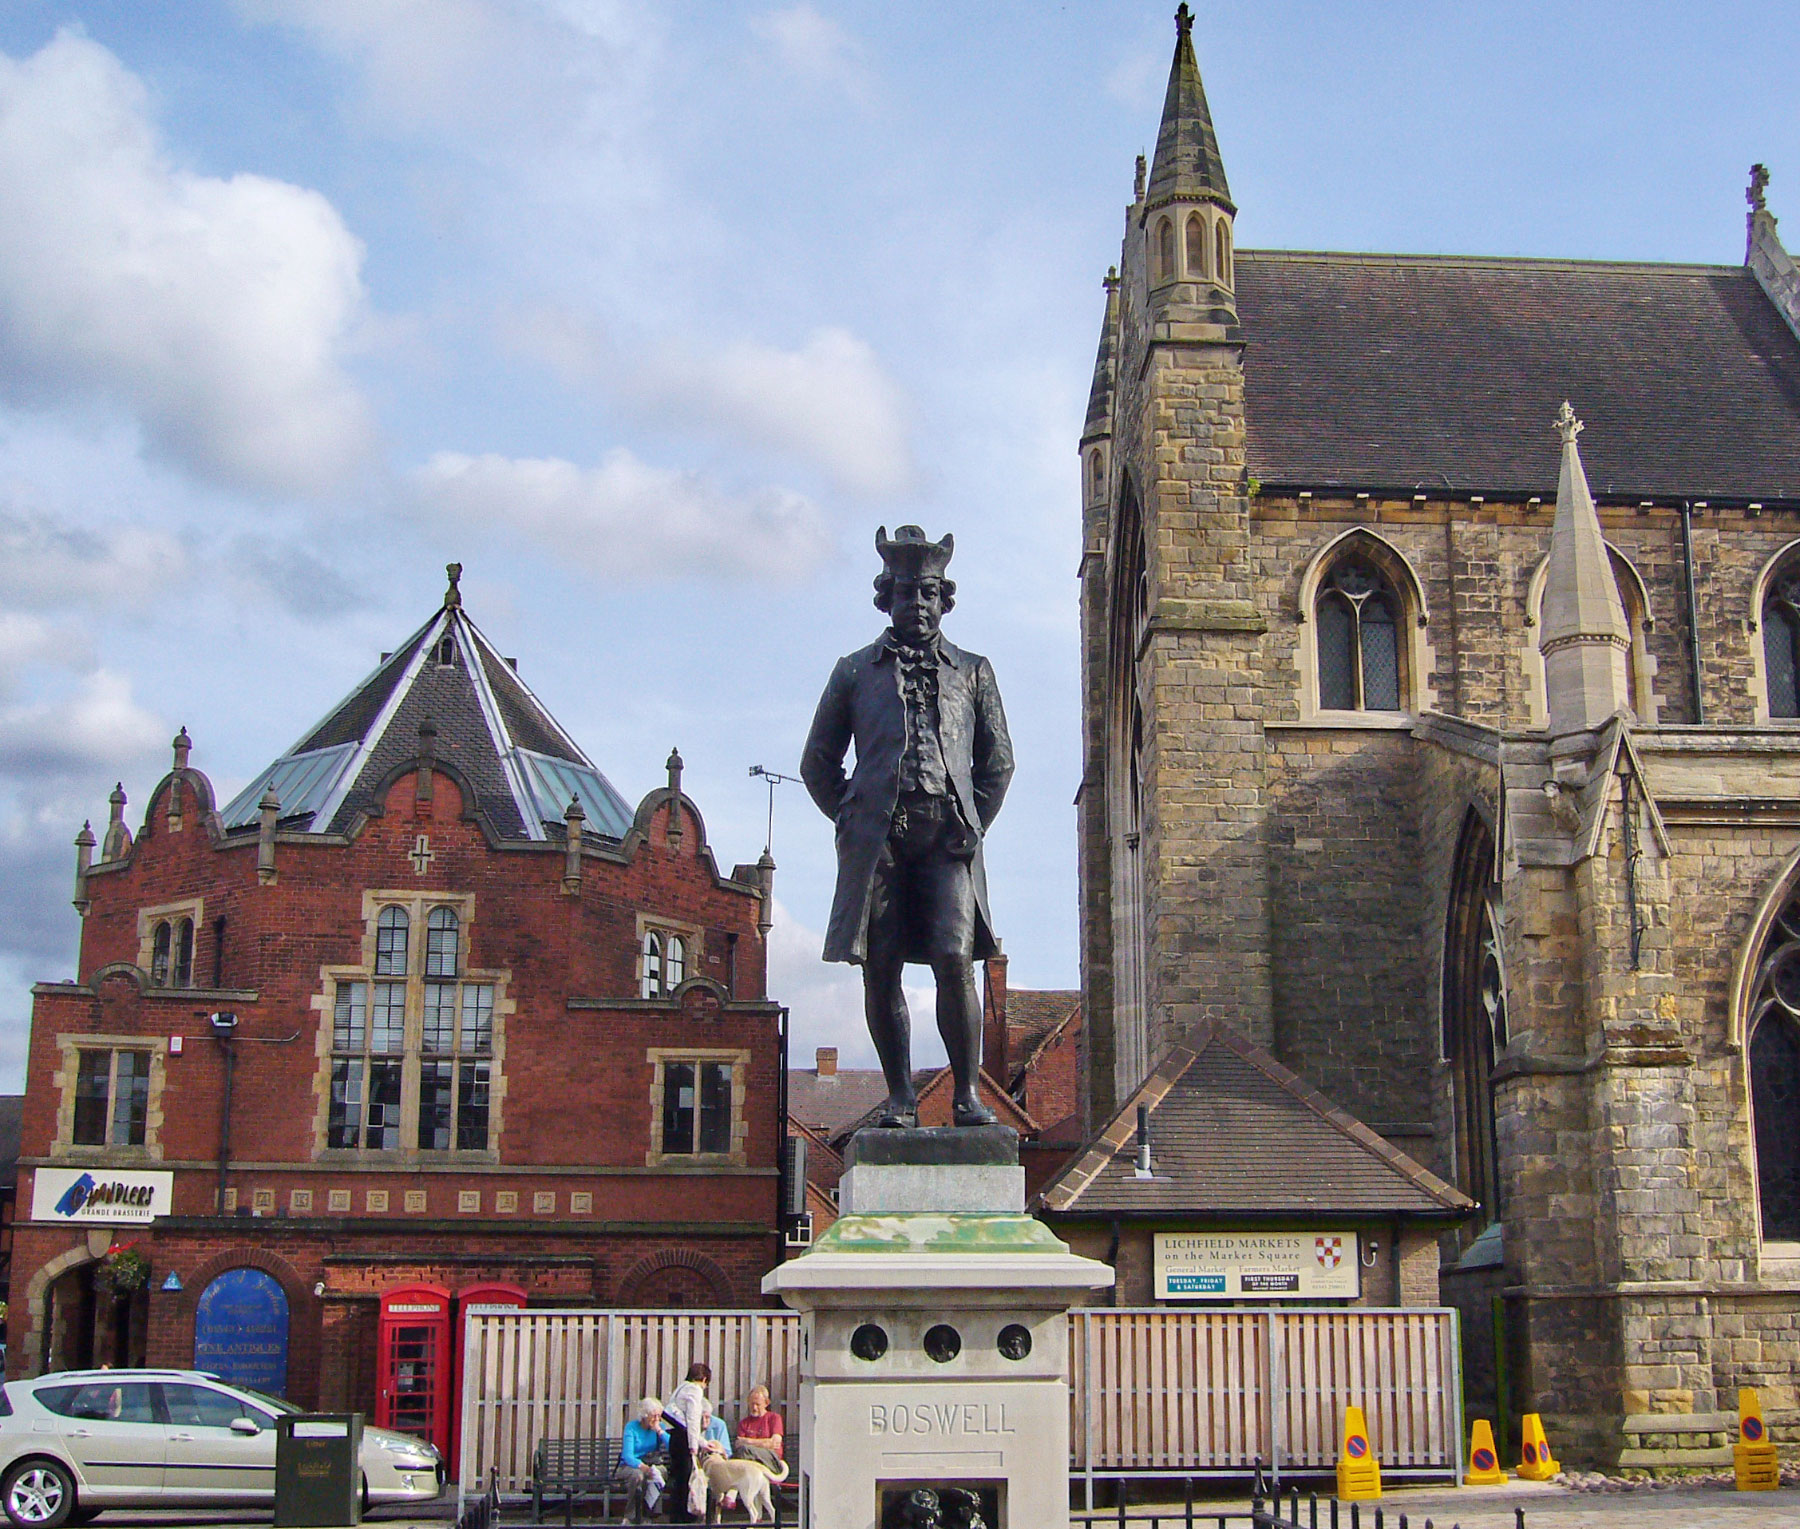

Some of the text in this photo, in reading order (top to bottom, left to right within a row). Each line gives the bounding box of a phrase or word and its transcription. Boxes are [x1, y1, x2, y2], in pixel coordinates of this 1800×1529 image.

[70, 1181, 155, 1209] CHANDLERS
[112, 1209, 150, 1217] BRASSERIE
[1165, 1239, 1301, 1249] LICHFIELD MARKETS
[1185, 1251, 1204, 1260] the
[1210, 1250, 1253, 1260] Market
[1258, 1250, 1300, 1262] Square
[1165, 1265, 1227, 1273] General Market
[1238, 1265, 1301, 1273] Farmers Market
[869, 1403, 1015, 1435] BOSWELL
